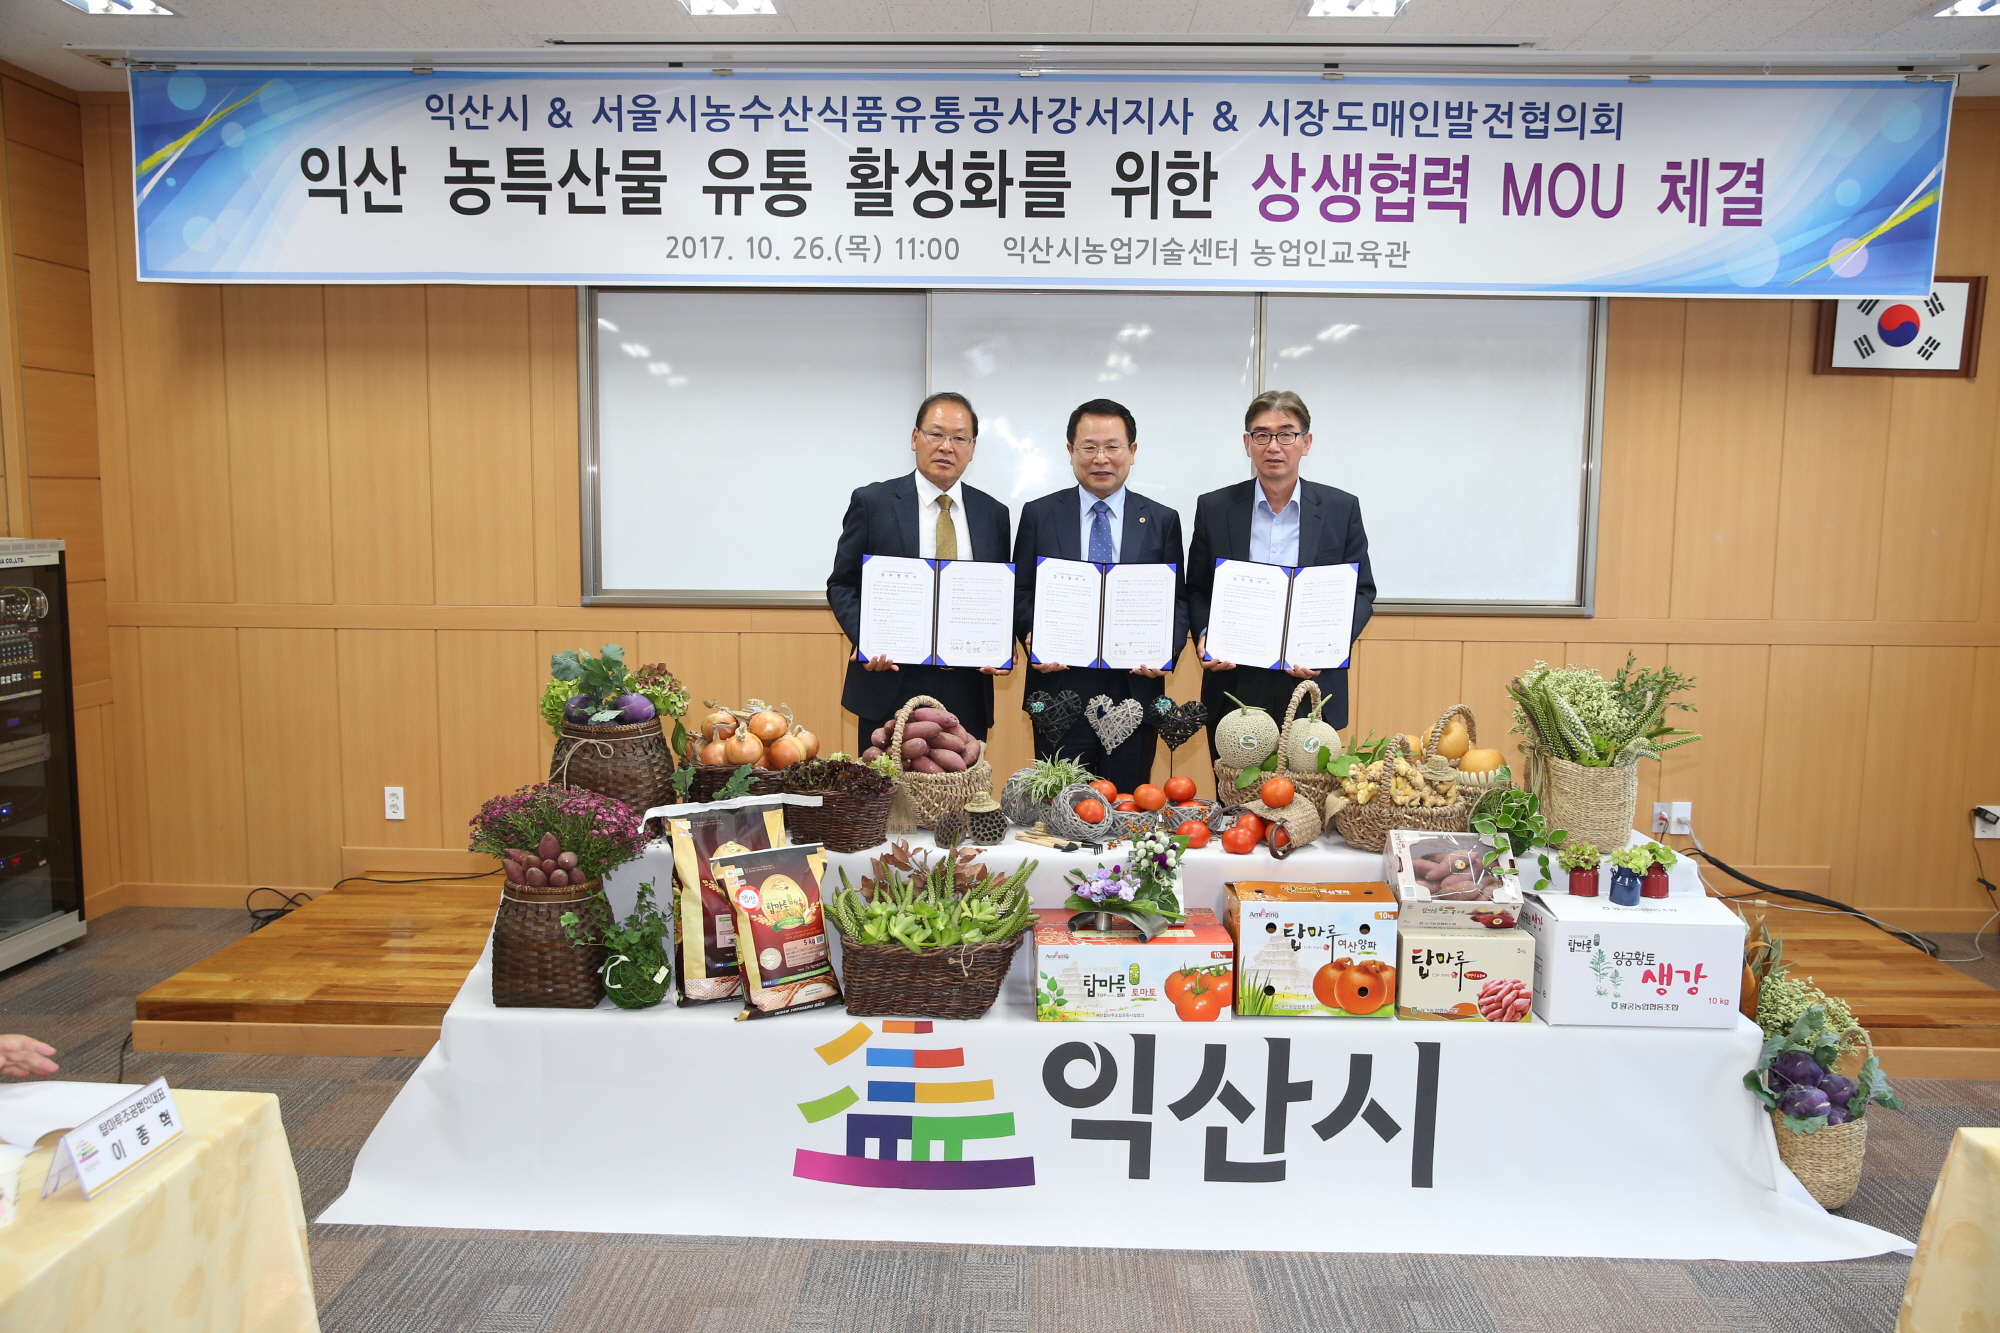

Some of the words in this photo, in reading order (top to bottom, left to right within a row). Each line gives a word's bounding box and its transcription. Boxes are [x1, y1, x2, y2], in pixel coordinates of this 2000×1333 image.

[425, 93, 528, 132] 익산시
[547, 96, 573, 129] &
[591, 93, 1194, 136] 서울시농수산식품유통공사강서지사
[1212, 100, 1239, 132] &
[1258, 98, 1624, 141] 시장도매인발전협의회
[300, 145, 407, 215] 익산
[443, 146, 668, 216] 농특산물
[702, 148, 813, 218] 유통
[846, 146, 1072, 219] 활성화를
[1110, 150, 1219, 220] 위한
[1251, 152, 1470, 224] 상생협력
[1502, 162, 1625, 219] MOU
[1656, 157, 1765, 227] 체결
[665, 235, 733, 261] 2017.
[746, 236, 781, 261] 10.
[793, 234, 882, 264] 26.(목)
[895, 237, 960, 261] 11:00
[1003, 235, 1238, 267] 익산시농업기술센터
[1250, 238, 1411, 269] 농업인교육관
[766, 899, 788, 915] 탑마루
[1378, 911, 1394, 920] 10kg
[1213, 951, 1226, 960] 10kg
[1283, 922, 1349, 964] 탑마루
[1568, 938, 1592, 953] 탑마루
[1411, 948, 1477, 993] 탑마루
[1612, 951, 1656, 967] 왕궁황토
[1083, 973, 1126, 998] 탑마루
[1641, 962, 1708, 996] 생강
[1130, 988, 1157, 997] 토마토
[1708, 997, 1718, 1005] 10
[1719, 997, 1730, 1006] kg
[1619, 1002, 1679, 1011] 왕궁농업협동조합
[98, 1086, 167, 1137] 탑마루조공법인대표
[1041, 1033, 1441, 1189] 익산시
